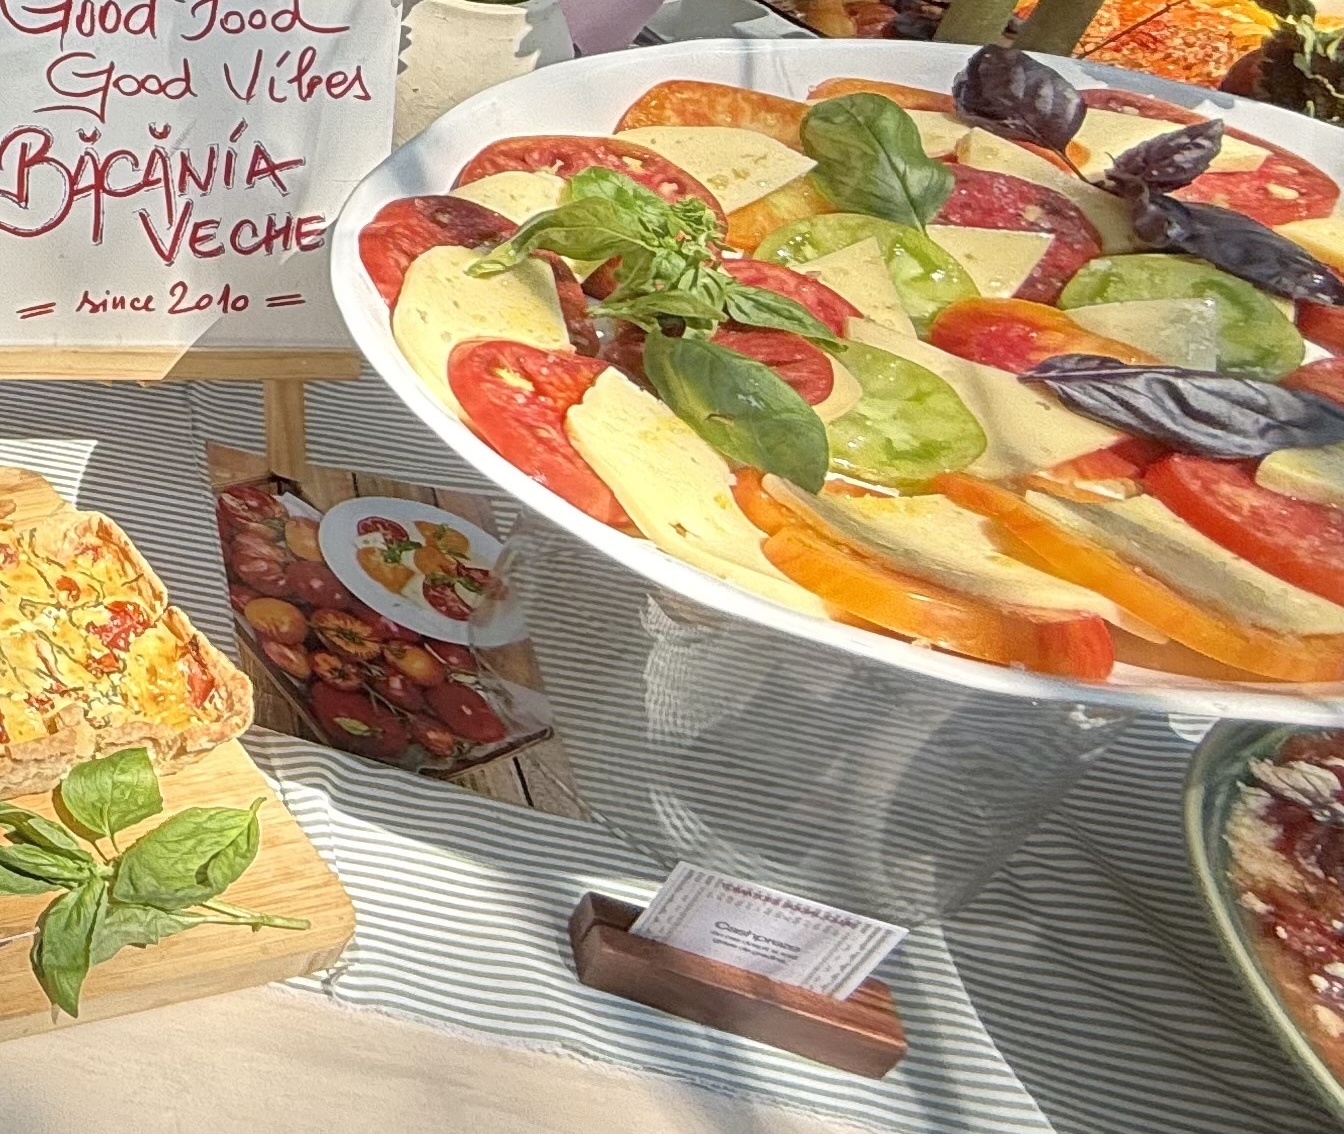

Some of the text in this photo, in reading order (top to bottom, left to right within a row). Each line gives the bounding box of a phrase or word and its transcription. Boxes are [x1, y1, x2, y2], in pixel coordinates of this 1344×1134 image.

[33, 51, 198, 123] Good
[133, 201, 328, 266] VECHE
[75, 280, 250, 316] since 2010
